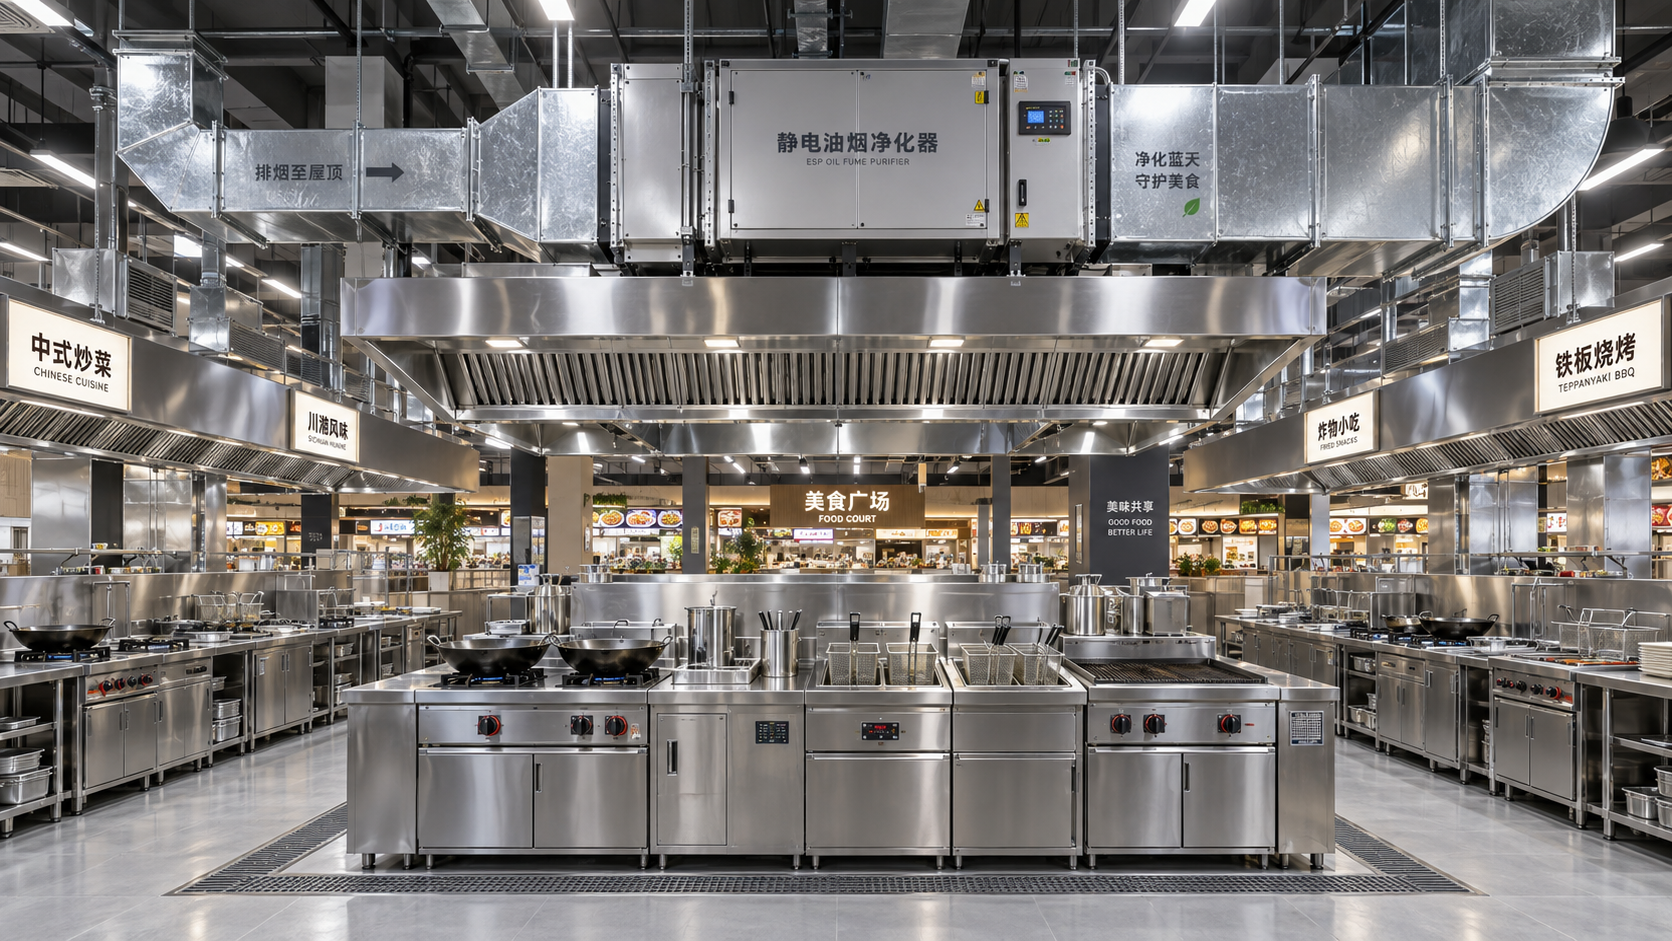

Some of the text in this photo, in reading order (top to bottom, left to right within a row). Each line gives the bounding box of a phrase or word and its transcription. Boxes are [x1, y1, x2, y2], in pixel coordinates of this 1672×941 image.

[777, 131, 938, 153] 静电油烟净化器
[806, 158, 910, 166] ESP OIL FUME PURIFIER
[1135, 151, 1200, 167] 净化蓝天
[255, 163, 343, 181] 排烟至屋顶
[1135, 173, 1200, 189] 守护美食
[31, 331, 112, 378] 中式炒菜
[1555, 332, 1636, 379] 铁板烧烤
[33, 366, 109, 393] CHINESE CUISINE
[1558, 366, 1635, 393] TEPPANYAKI BBQ
[804, 490, 890, 512] 美食广场
[1106, 500, 1154, 513] 美味共享
[818, 515, 877, 523] FOOD COURT
[1108, 518, 1153, 526] GOOD FOOD
[1107, 528, 1153, 536] BETTER LIFE
